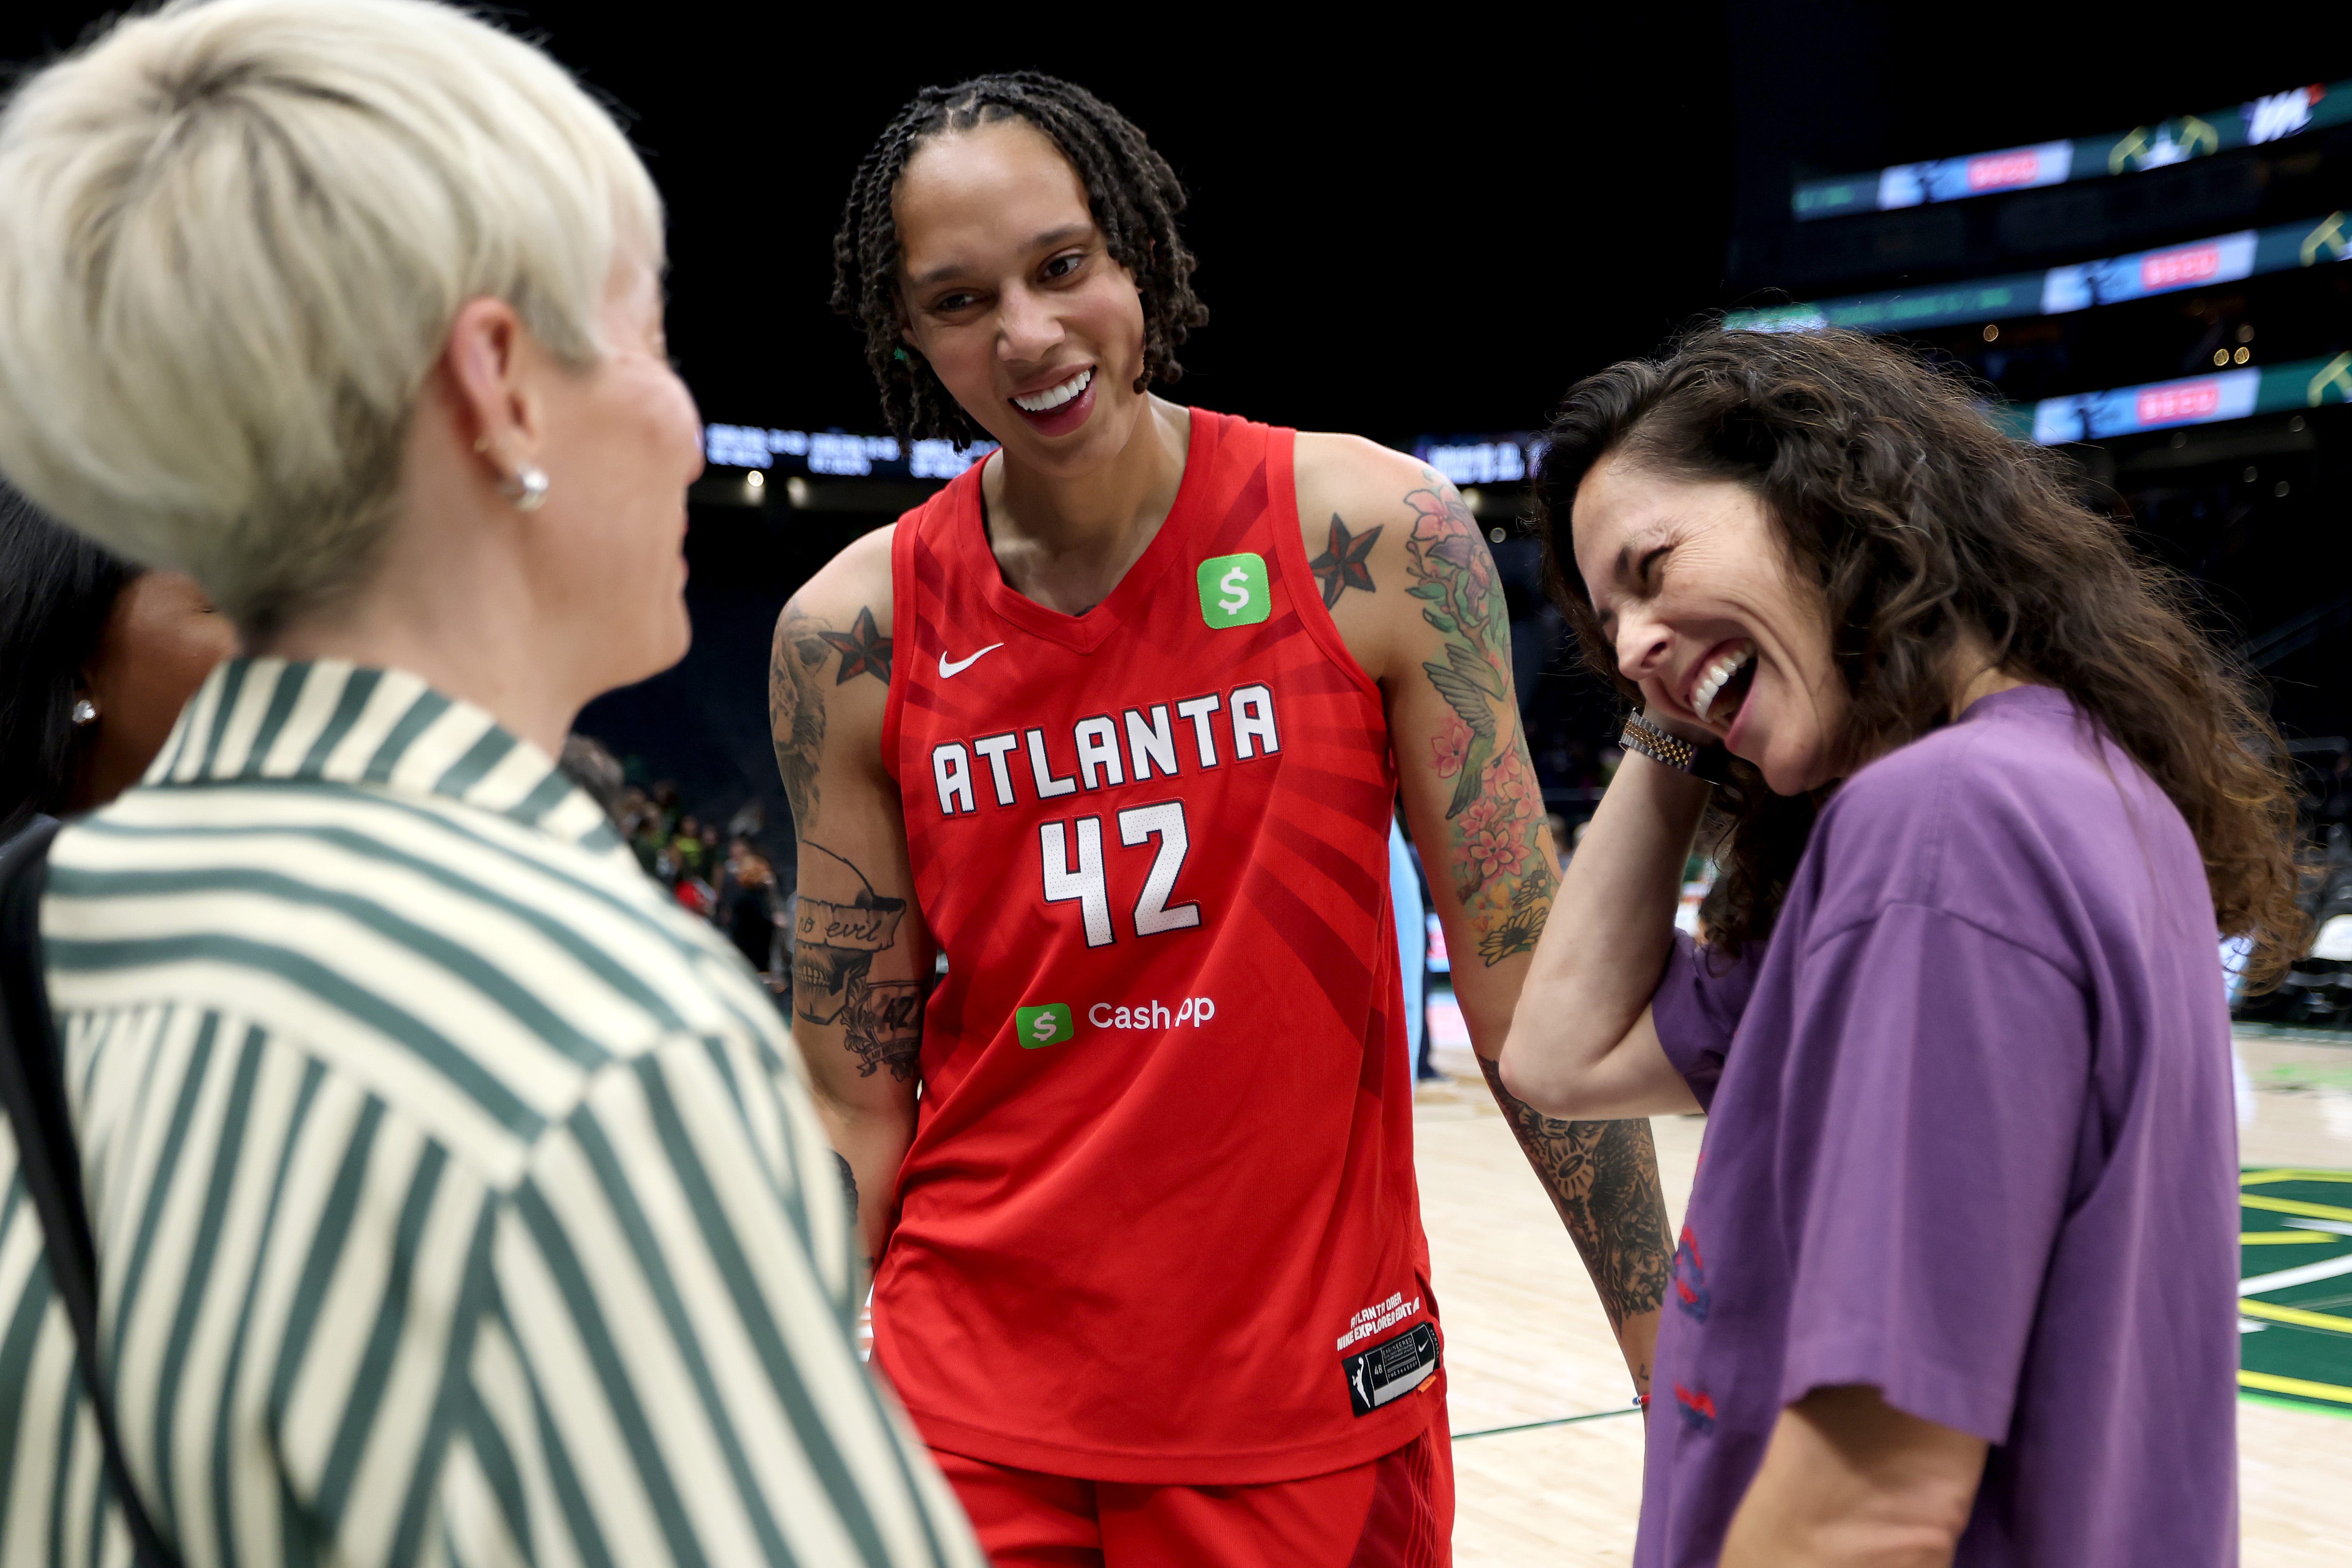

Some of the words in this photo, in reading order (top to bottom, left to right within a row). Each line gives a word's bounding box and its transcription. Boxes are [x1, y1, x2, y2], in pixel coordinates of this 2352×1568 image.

[932, 684, 1280, 816] ATLANTA
[1039, 802, 1202, 948] 42
[825, 919, 881, 941] evil
[1088, 1000, 1170, 1030] Cash
[1175, 997, 1215, 1027] pp
[1351, 1302, 1385, 1329] ATLANTA
[1386, 1292, 1402, 1311] DREA
[1337, 1330, 1354, 1351] NIKE
[1354, 1312, 1396, 1341] EXPLORER
[1374, 1363, 1383, 1375] 48
